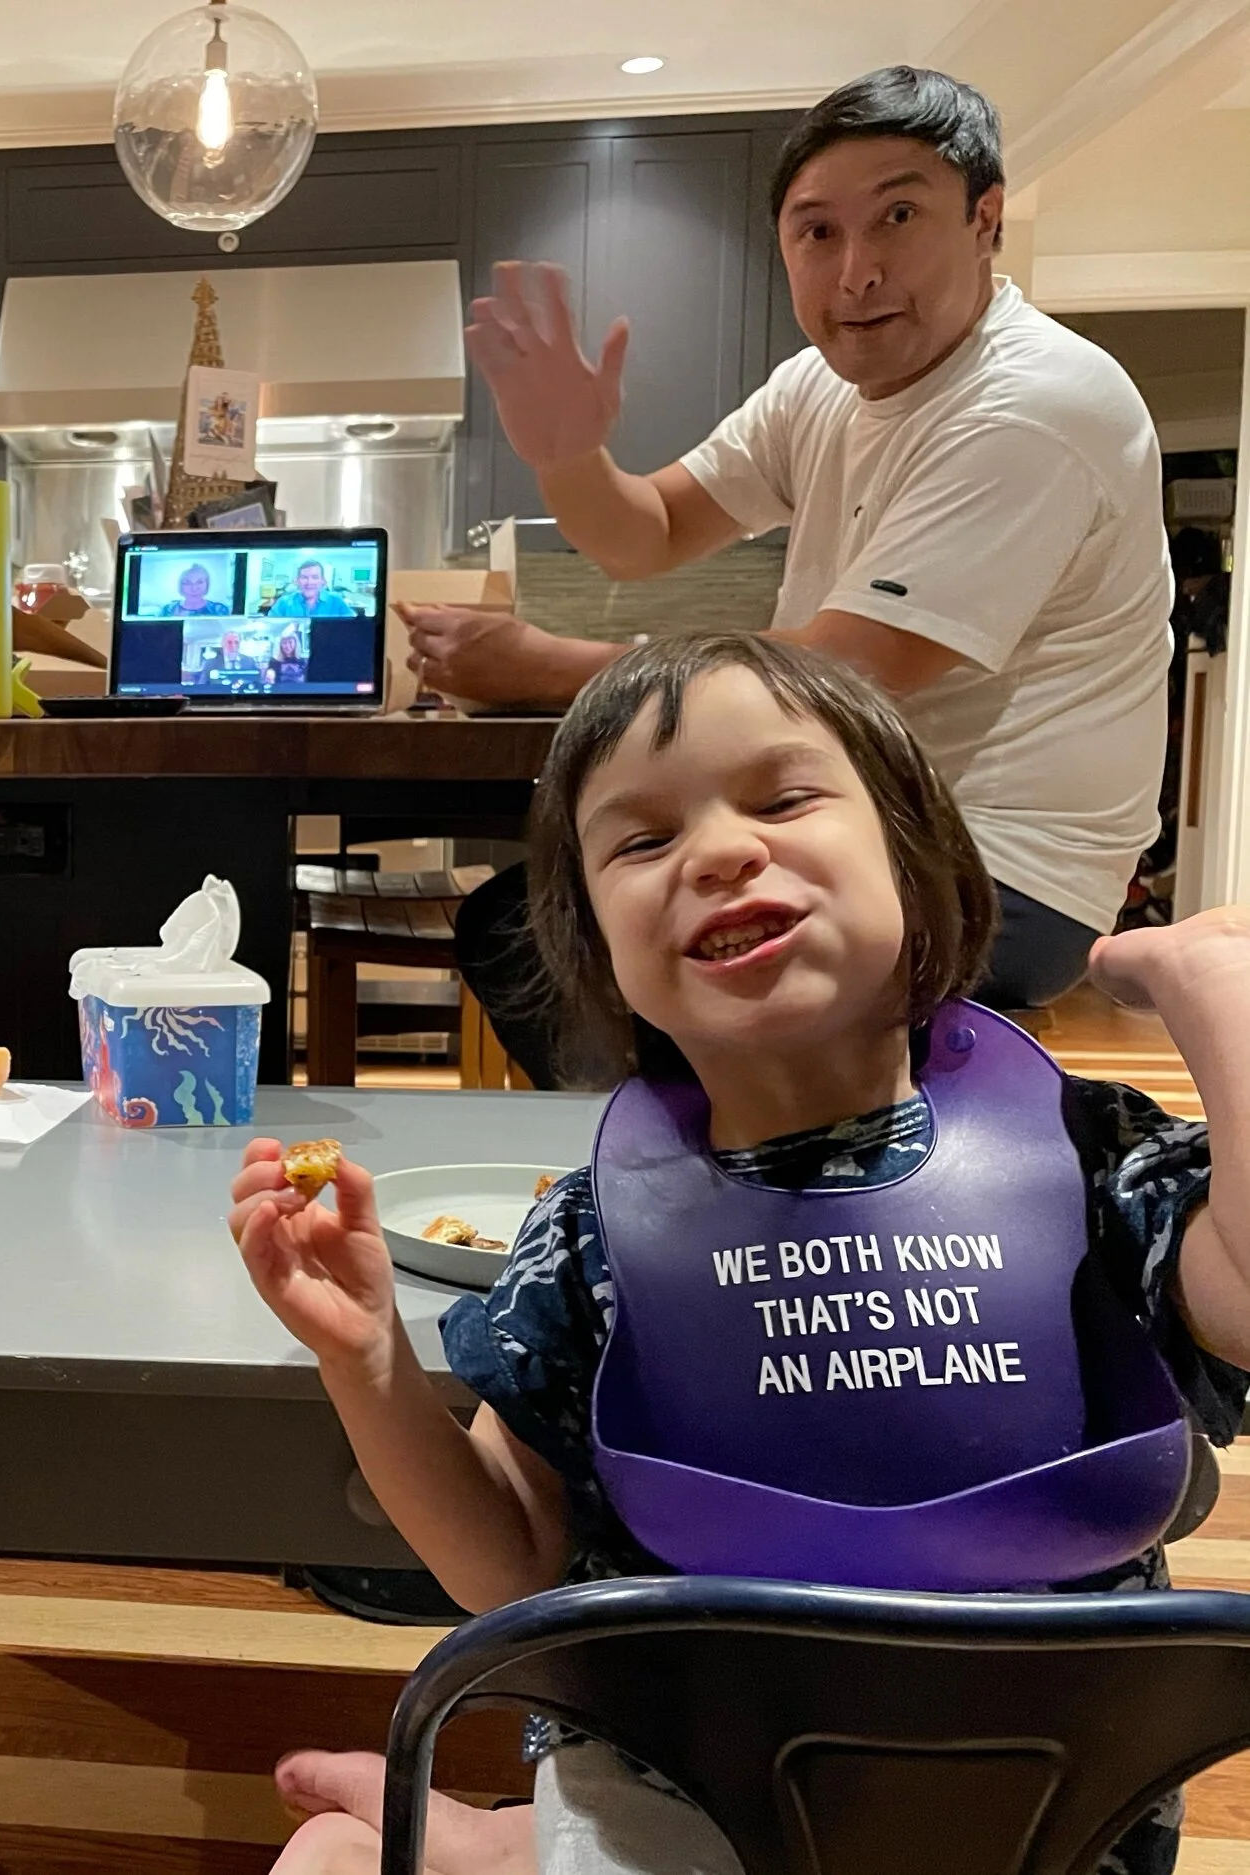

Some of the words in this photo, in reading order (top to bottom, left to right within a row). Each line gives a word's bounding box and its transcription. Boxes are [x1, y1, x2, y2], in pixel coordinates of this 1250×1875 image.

[712, 1244, 771, 1286] WE
[778, 1234, 883, 1279] BOTH
[893, 1234, 1004, 1272] KNOW
[754, 1290, 895, 1338] THAT'S
[904, 1285, 980, 1327] NOT
[758, 1354, 813, 1395] AN
[826, 1342, 1027, 1391] AIRPLANE
